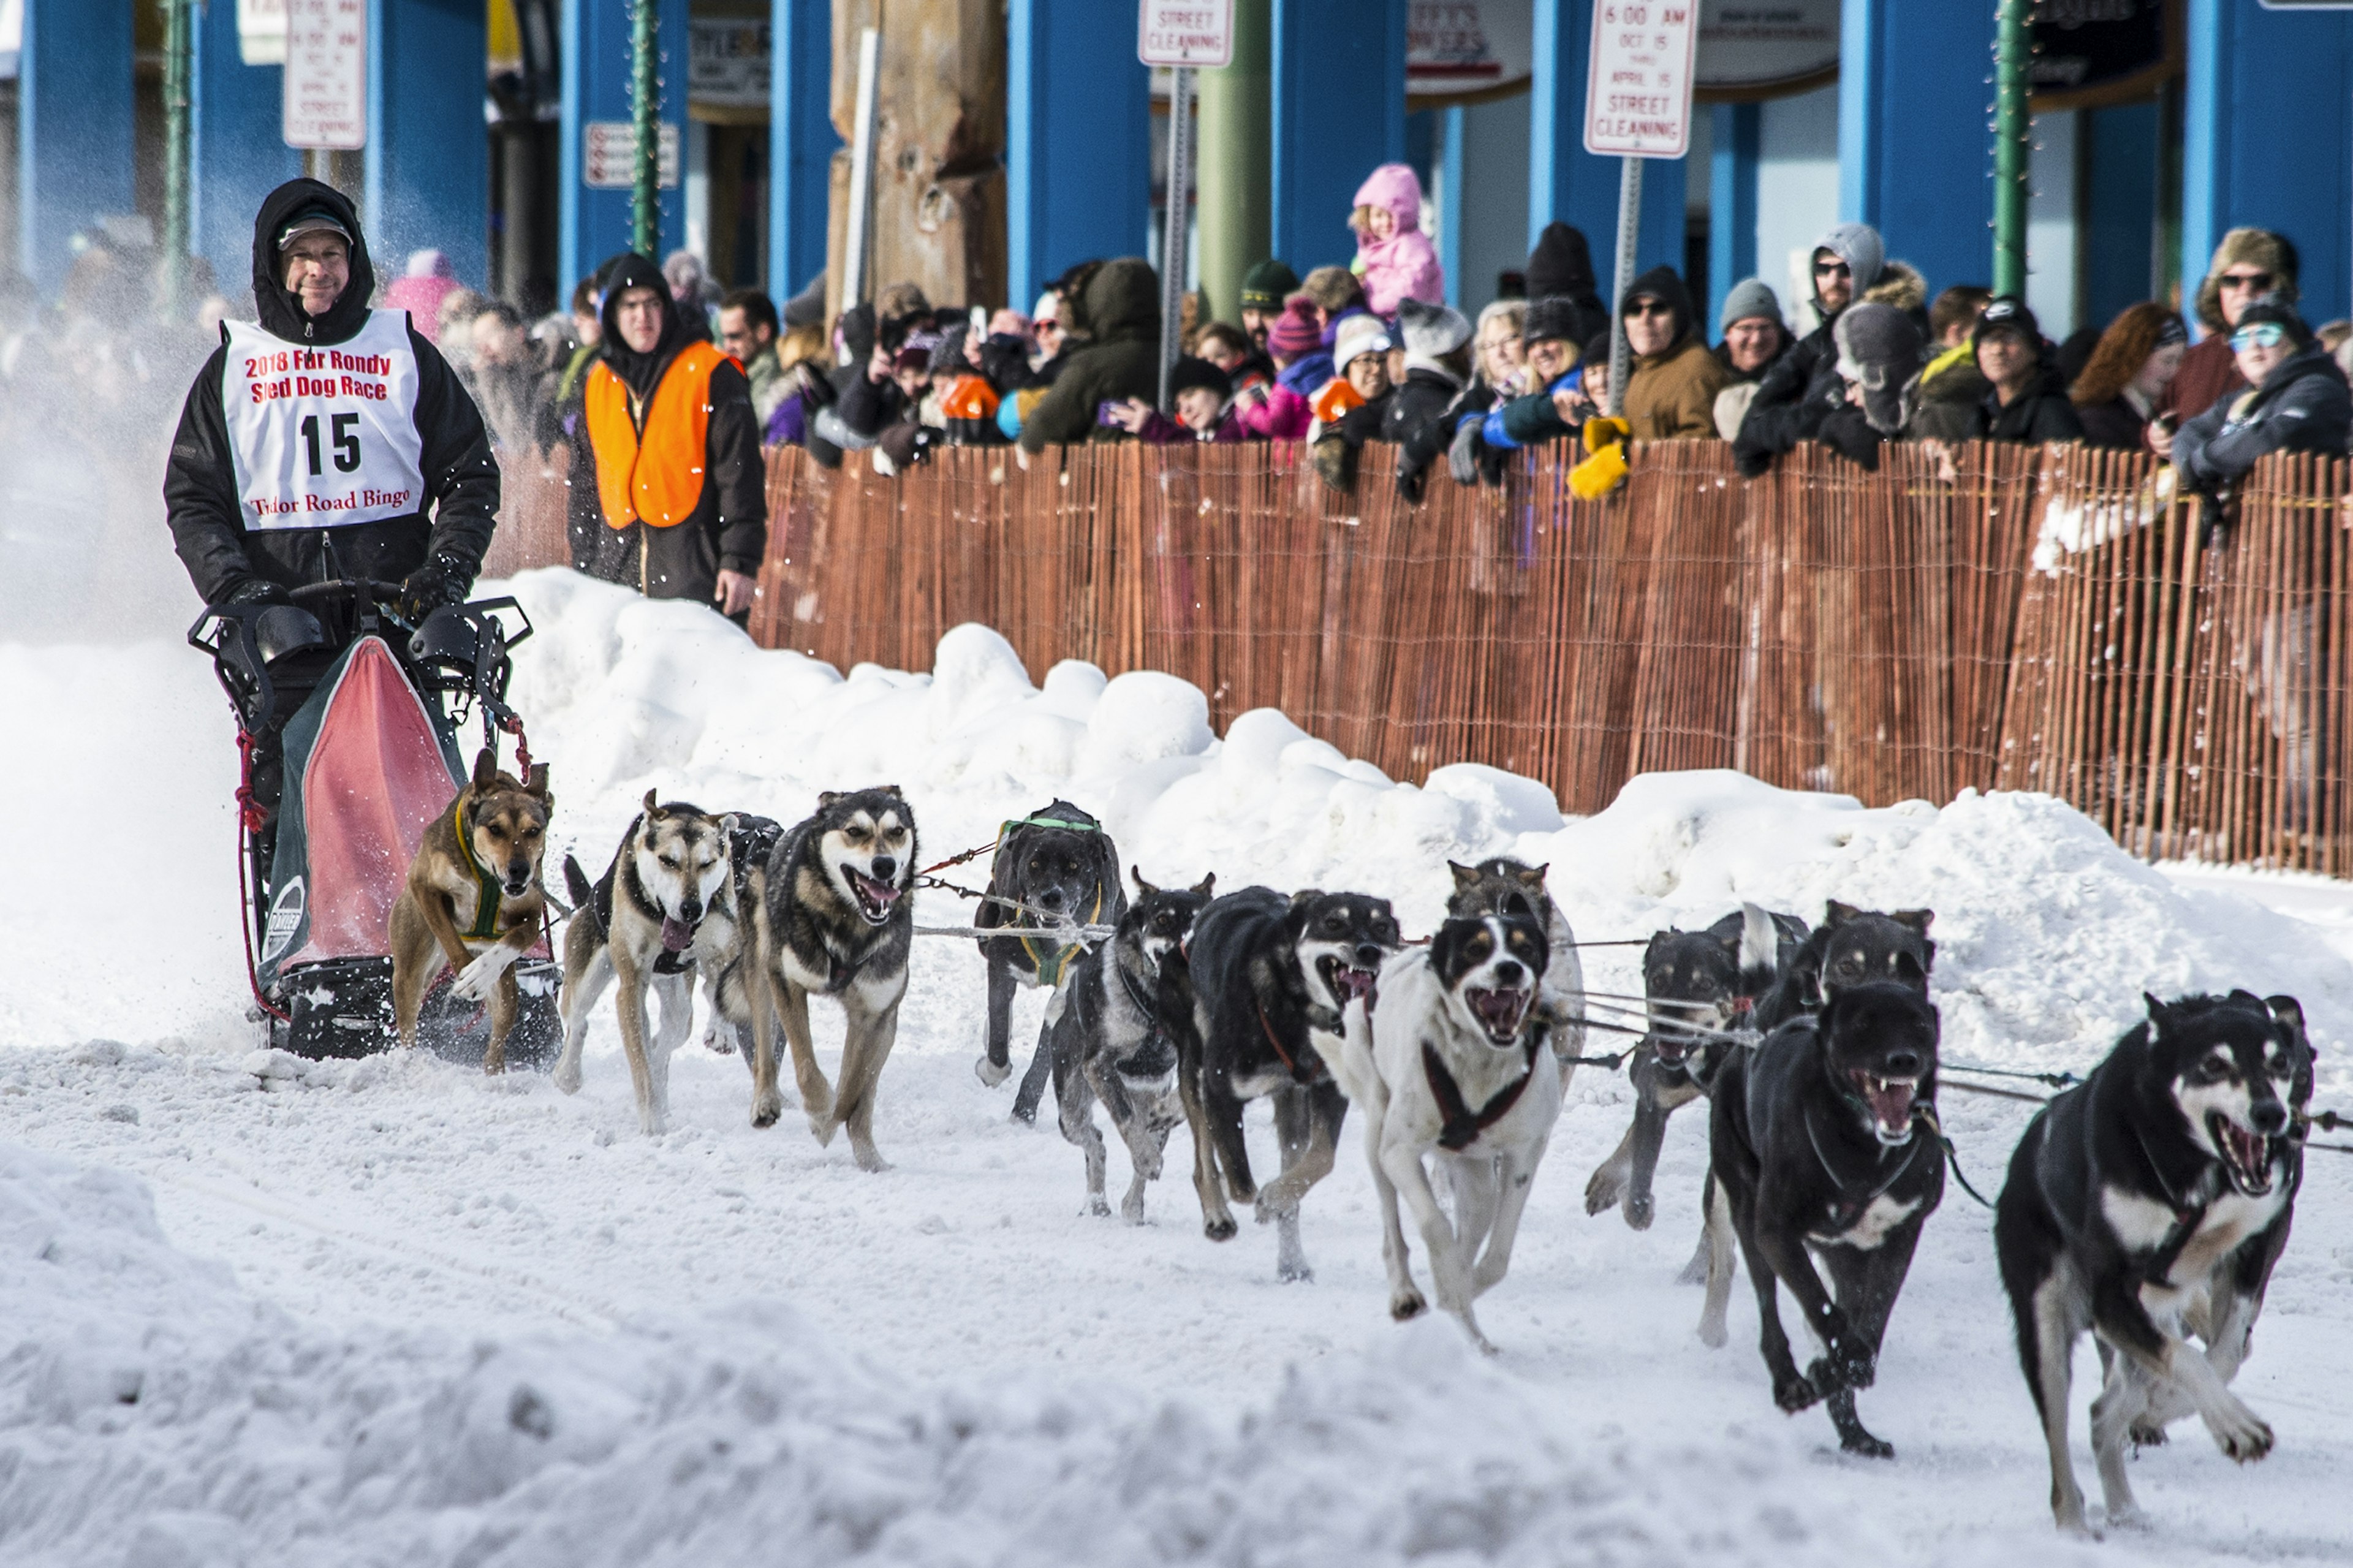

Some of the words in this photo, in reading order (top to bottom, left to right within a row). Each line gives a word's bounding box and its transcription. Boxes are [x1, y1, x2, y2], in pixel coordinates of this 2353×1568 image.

[1157, 10, 1214, 29] STREET
[1661, 9, 1686, 27] AM
[1148, 32, 1223, 51] CLEANING
[1619, 33, 1643, 48] OCT
[1611, 70, 1646, 86] APRIL
[1607, 94, 1670, 116] STREET
[1594, 118, 1677, 141] CLEANING
[245, 352, 289, 378] 2018
[294, 350, 326, 371] Fur
[330, 350, 391, 377] Rondy
[251, 377, 292, 404] Sled
[297, 376, 336, 398] Dog
[341, 375, 388, 401] Race
[300, 412, 362, 476] 15
[305, 491, 358, 512] Road
[362, 489, 410, 509] Bingo
